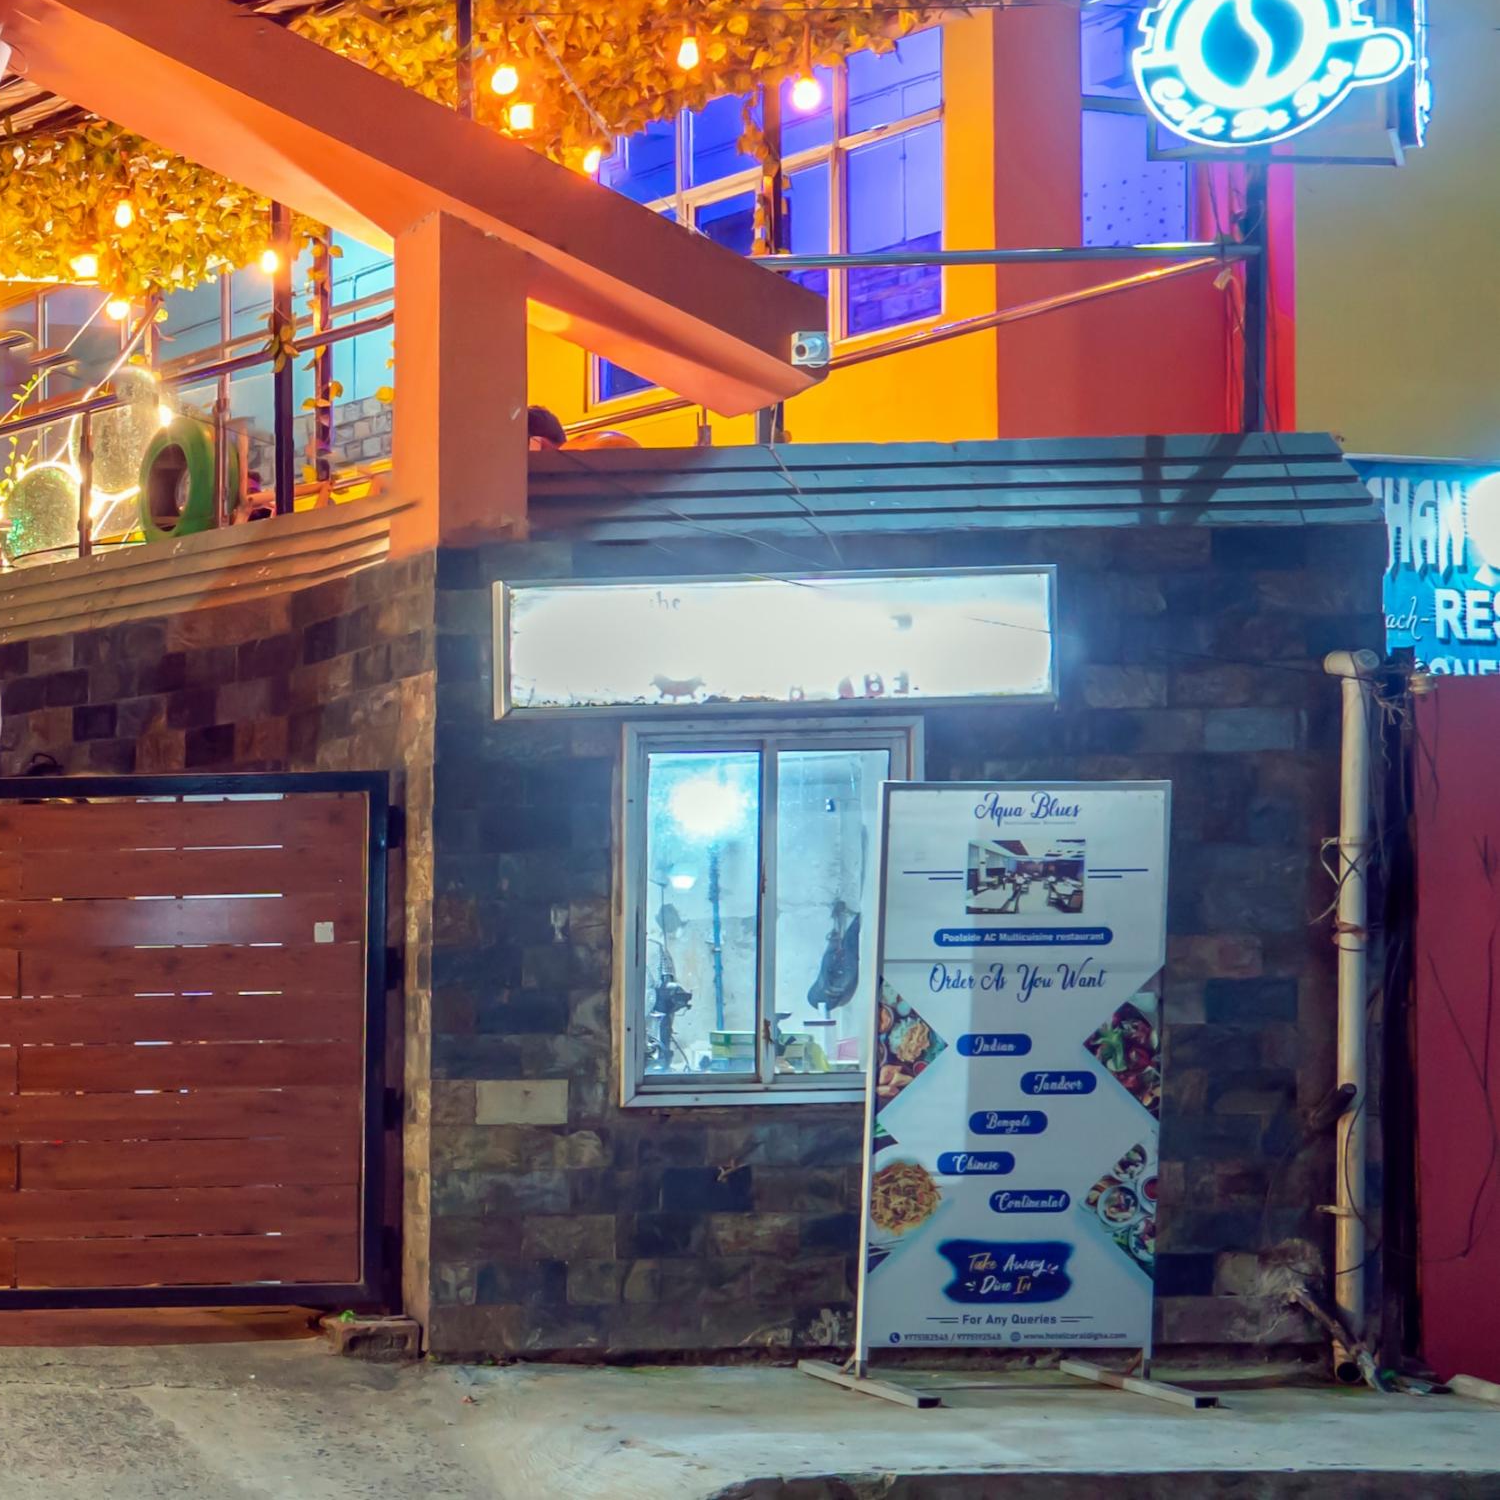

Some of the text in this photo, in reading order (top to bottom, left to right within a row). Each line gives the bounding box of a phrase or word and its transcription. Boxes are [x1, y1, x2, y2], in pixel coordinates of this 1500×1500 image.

[974, 791, 1082, 827] Aqua Blues
[942, 932, 1104, 942] Poolside AC Multicuisine restaurant
[929, 957, 1107, 1003] Order As You Want
[972, 1036, 1016, 1054] Indian
[1033, 1073, 1083, 1093] Tandoor
[986, 1112, 1031, 1133] Bengali
[952, 1154, 1000, 1173] Chinese
[994, 1192, 1066, 1211] Continental
[968, 1252, 1048, 1277] Take Away
[979, 1275, 1031, 1295] Dine In
[962, 1314, 1057, 1326] For Any Queries
